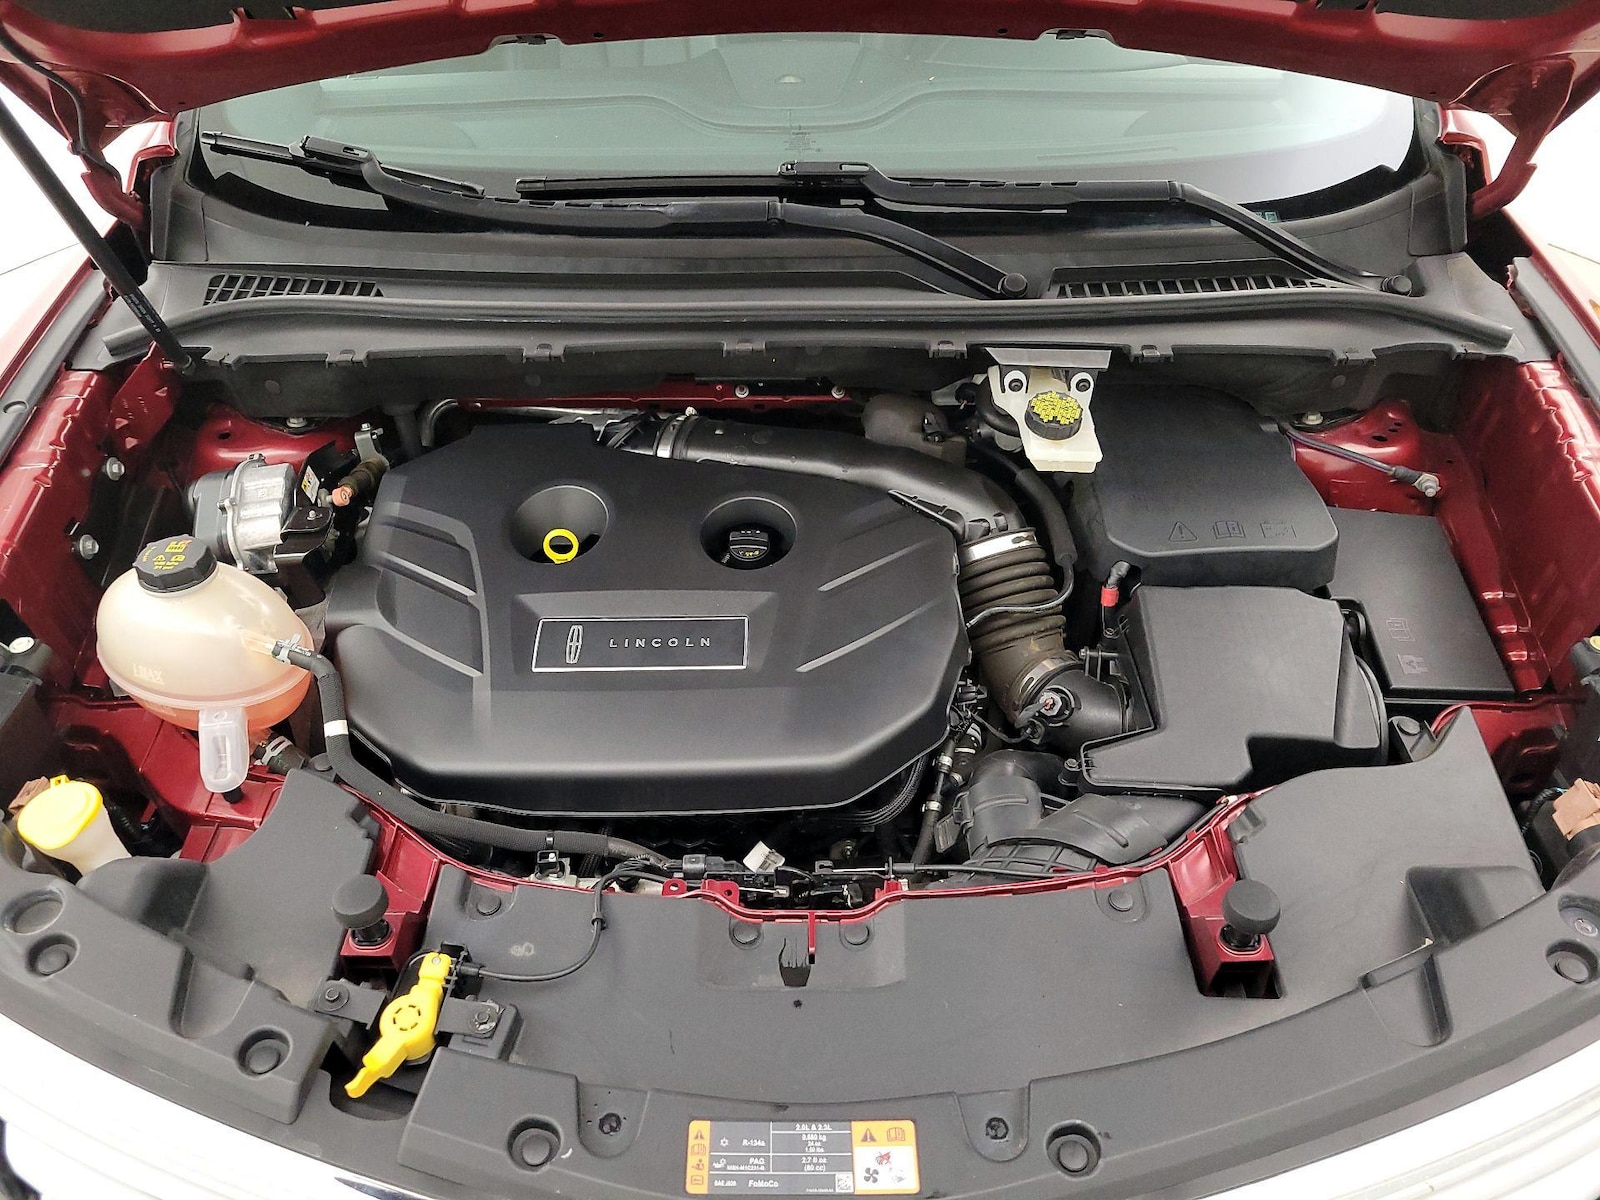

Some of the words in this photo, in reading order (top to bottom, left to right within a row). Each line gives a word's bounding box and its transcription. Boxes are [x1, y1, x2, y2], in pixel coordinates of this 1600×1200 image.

[609, 637, 711, 648] LINCOLN
[742, 1138, 766, 1147] R-134a
[749, 1157, 765, 1165] PAG
[748, 1179, 779, 1188] FoMoCo
